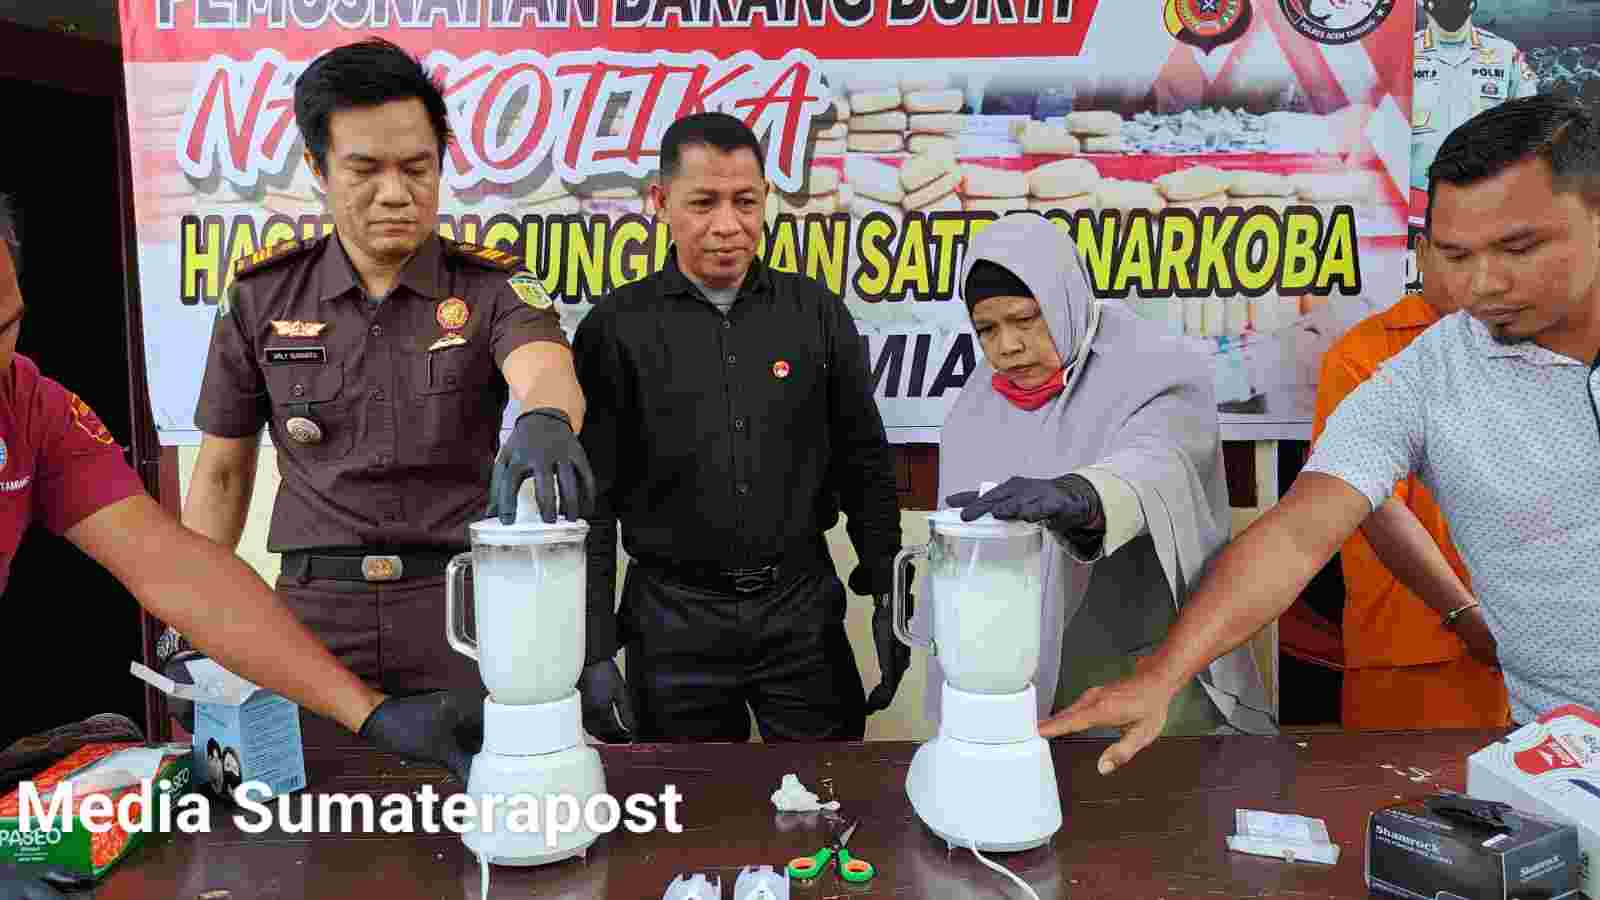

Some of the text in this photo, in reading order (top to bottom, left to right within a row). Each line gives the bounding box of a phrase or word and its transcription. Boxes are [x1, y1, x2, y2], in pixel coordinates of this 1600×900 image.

[179, 49, 827, 192] NKOTIKA
[853, 206, 1361, 303] SATNARKOBA
[0, 828, 62, 847] PASEO
